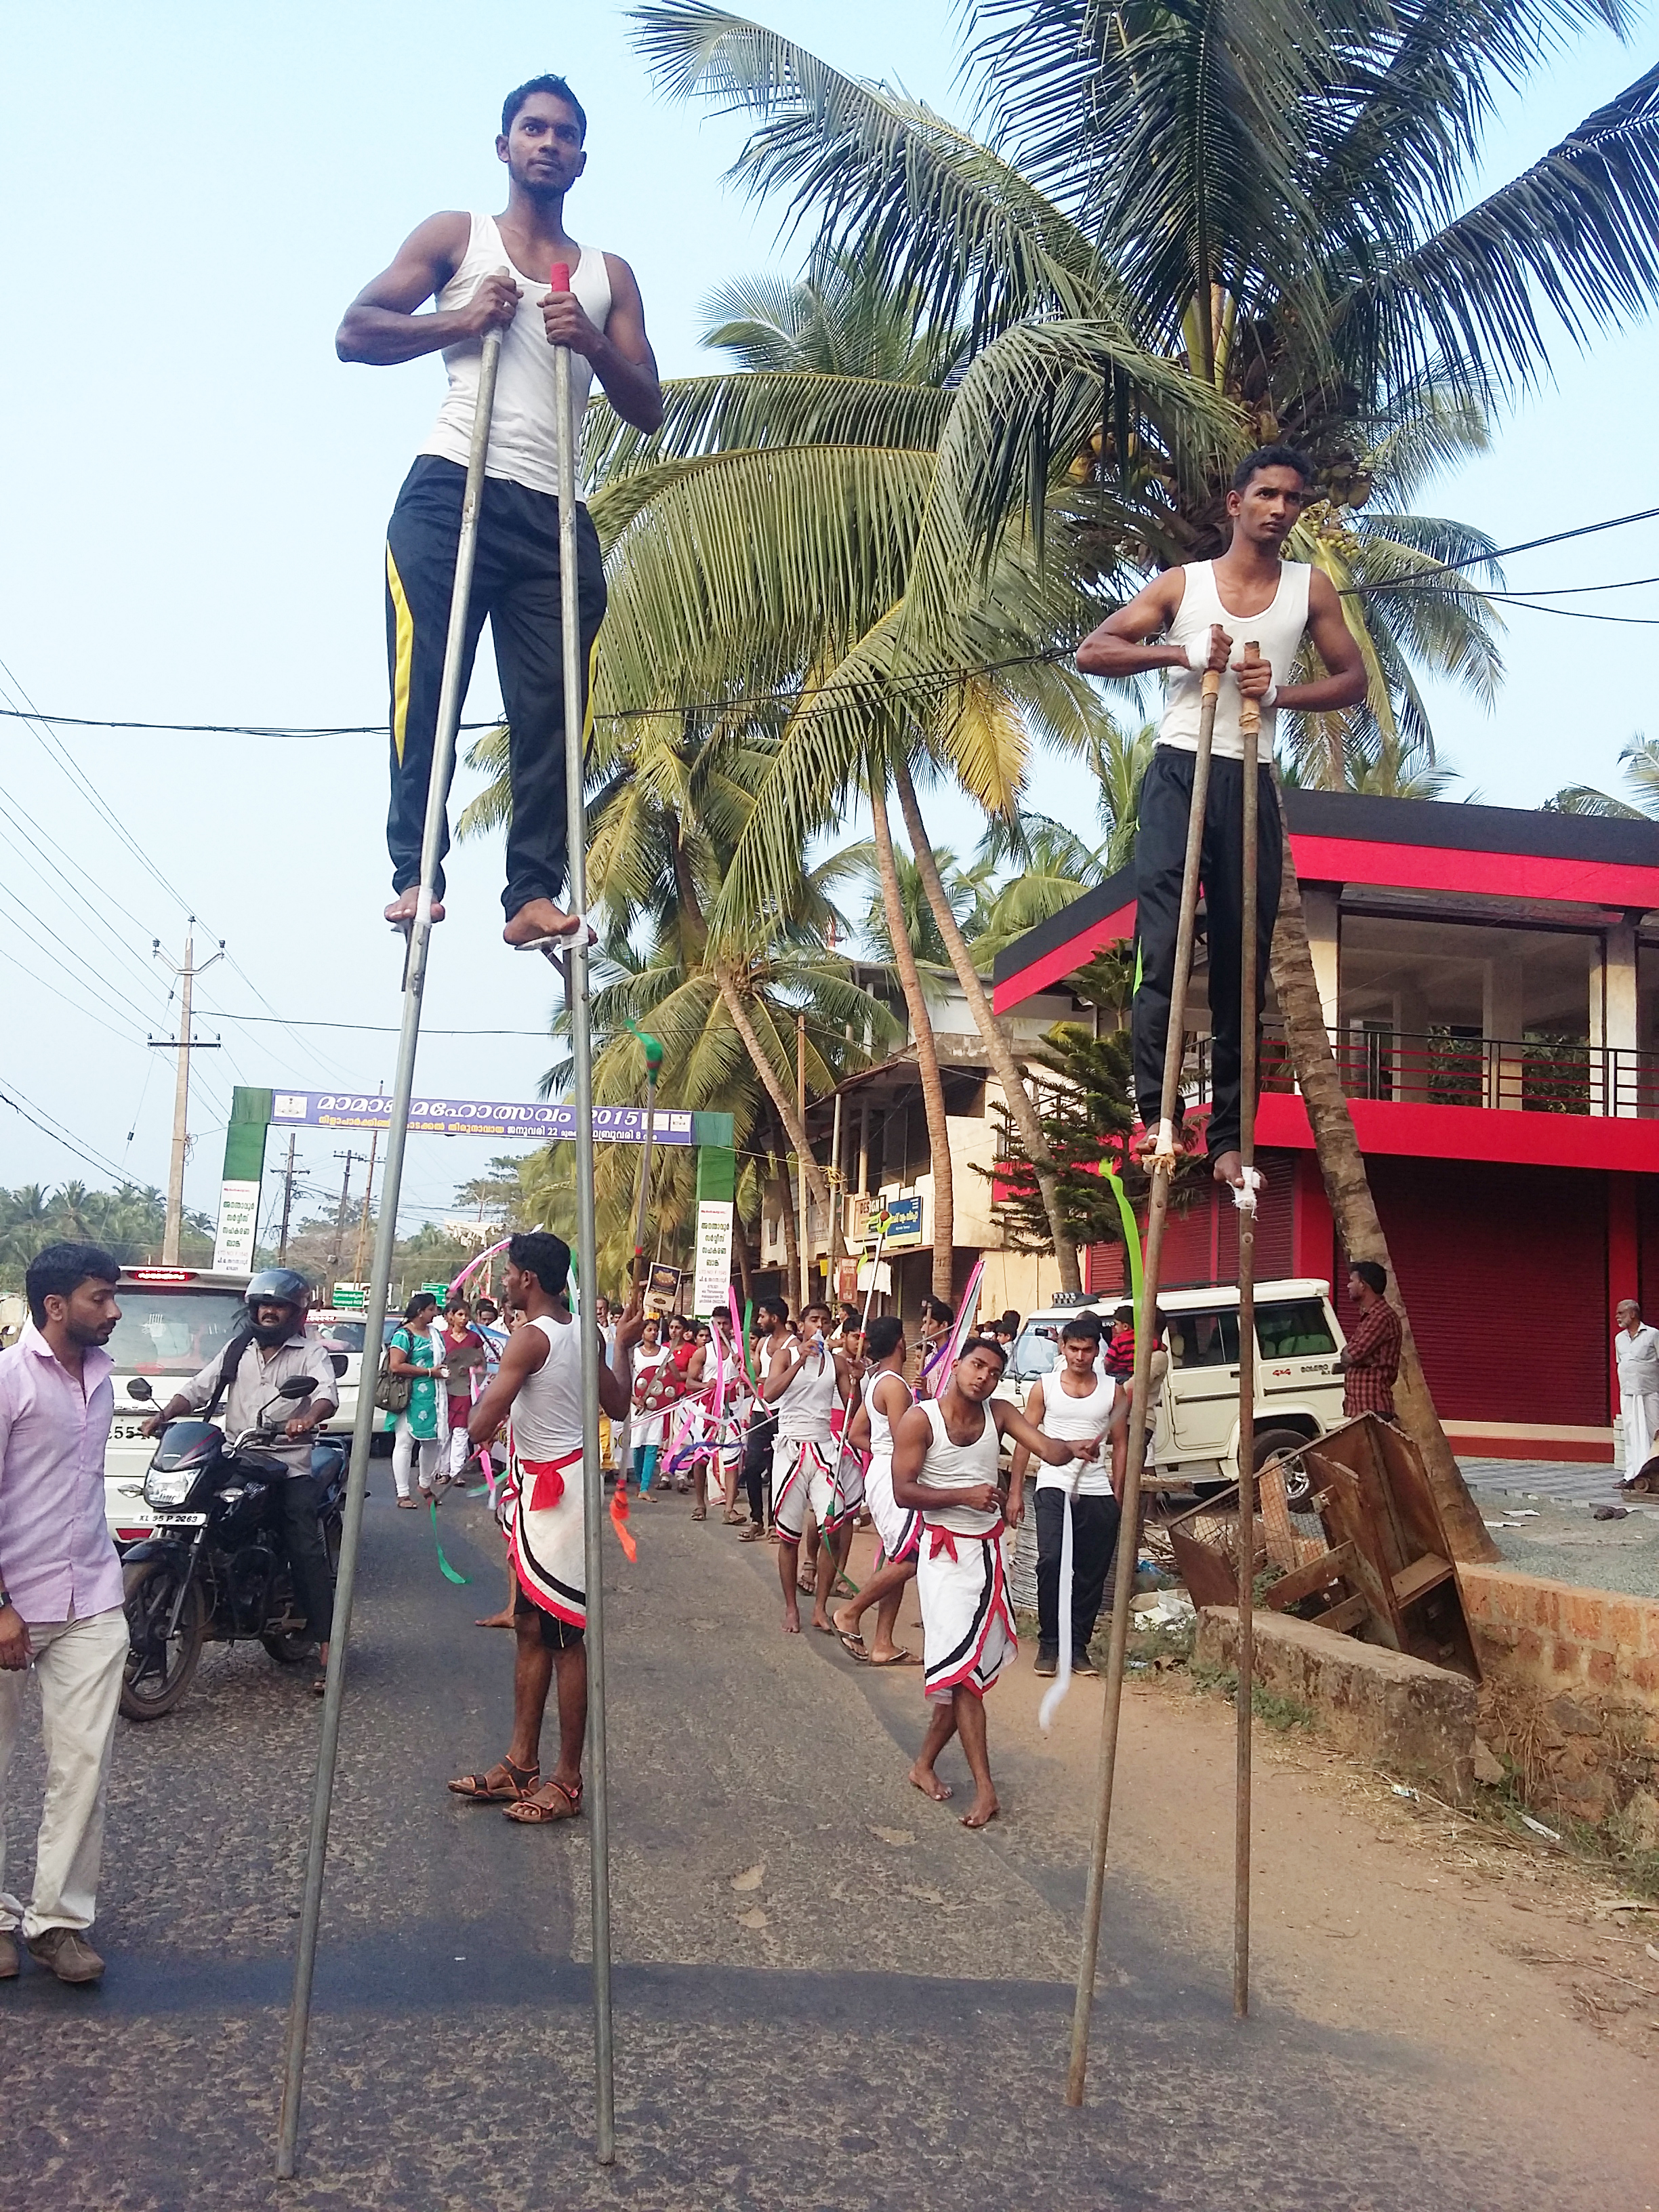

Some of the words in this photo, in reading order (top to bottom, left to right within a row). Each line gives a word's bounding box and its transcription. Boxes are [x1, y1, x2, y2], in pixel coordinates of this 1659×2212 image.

[411, 1101, 571, 1123] മഹോത്സവം
[507, 1125, 546, 1136] ജനുവരി
[547, 1127, 558, 1136] 22
[636, 1131, 641, 1140] 8
[860, 1199, 880, 1214] DESIGN
[222, 1227, 250, 1235] സഹകരണ
